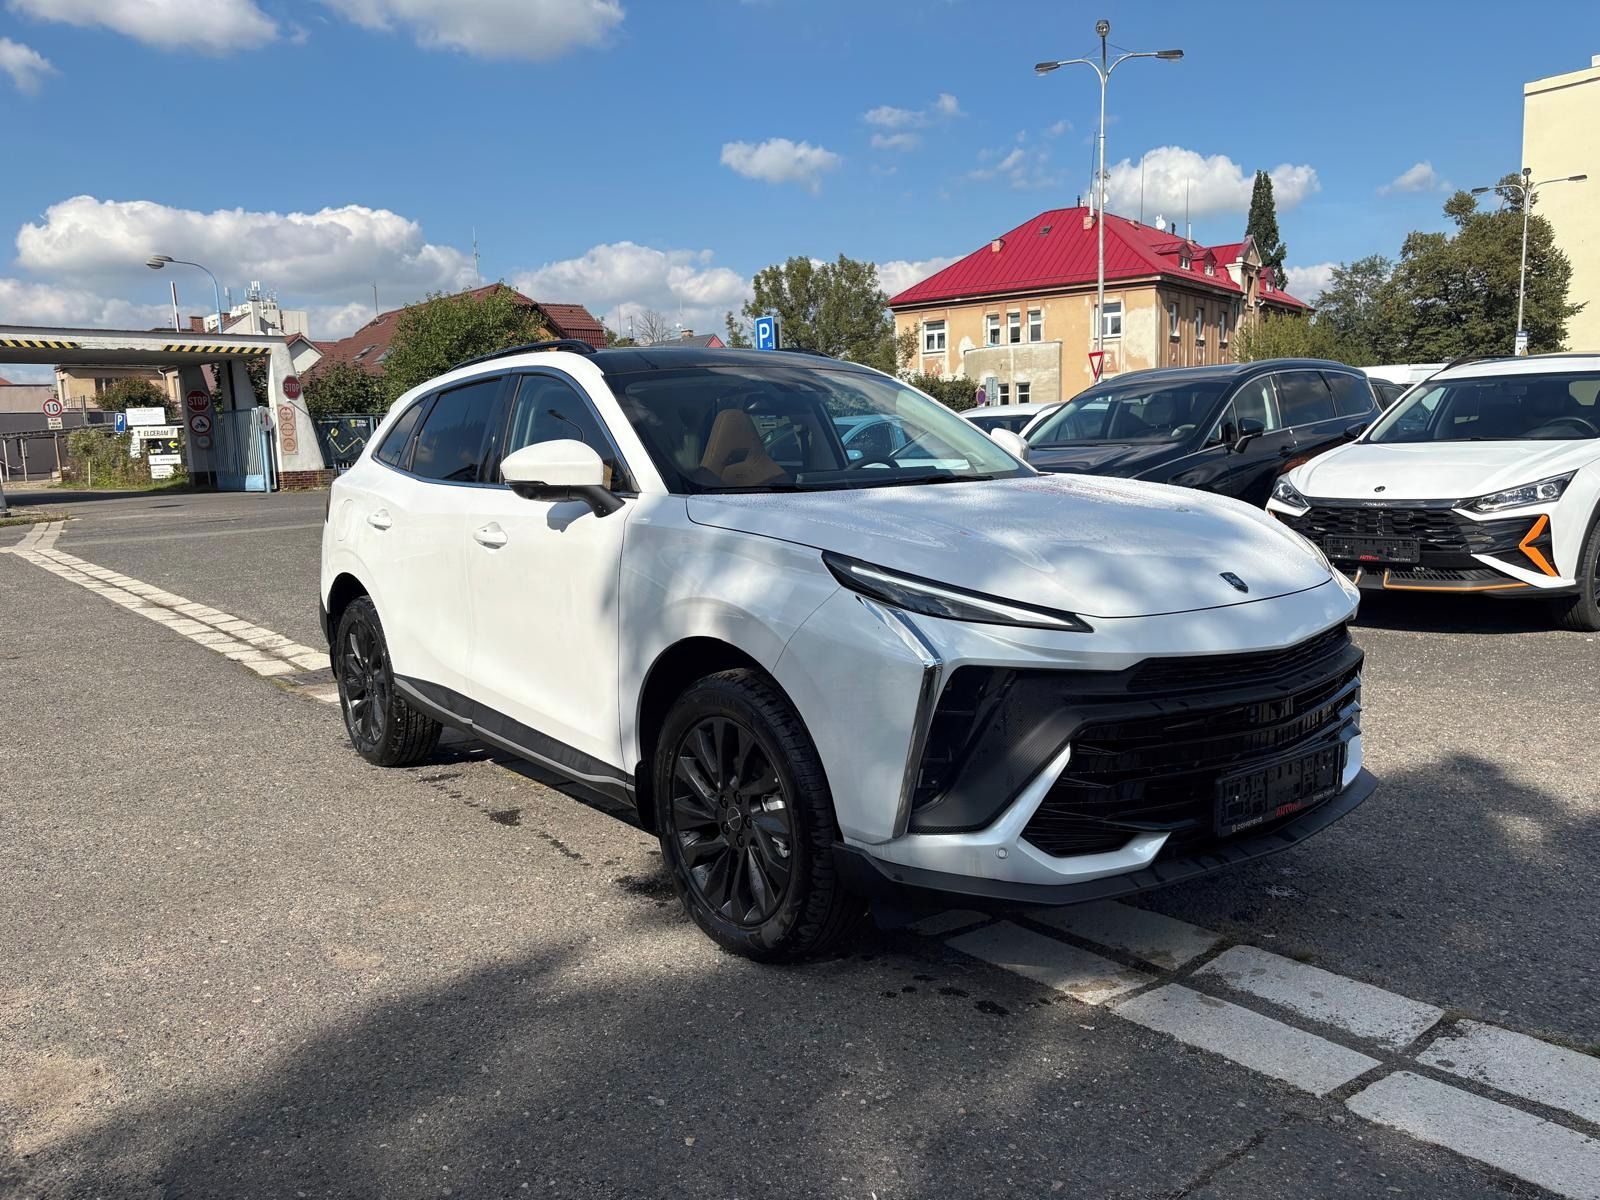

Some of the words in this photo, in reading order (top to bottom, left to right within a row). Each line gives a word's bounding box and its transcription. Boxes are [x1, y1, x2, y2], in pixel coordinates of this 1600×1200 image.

[759, 323, 770, 348] P
[284, 383, 300, 393] STOP
[188, 396, 208, 406] STOP
[47, 404, 59, 412] 10
[117, 415, 123, 426] P
